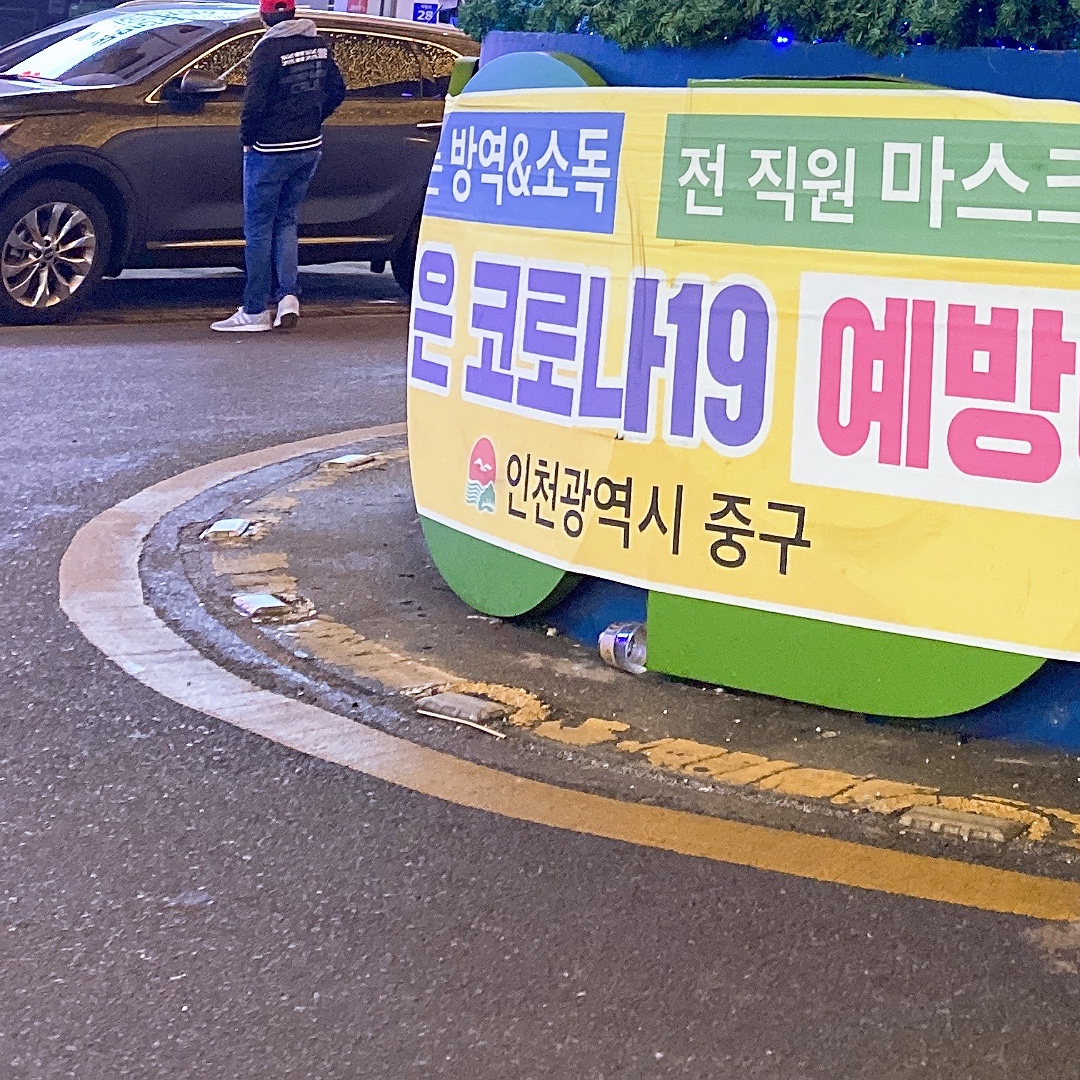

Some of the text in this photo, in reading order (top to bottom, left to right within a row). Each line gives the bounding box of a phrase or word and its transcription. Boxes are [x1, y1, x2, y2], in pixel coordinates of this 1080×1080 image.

[416, 10, 434, 21] 28
[450, 125, 611, 213] 방역&소독
[677, 143, 726, 217] 전
[748, 145, 856, 224] 직원
[411, 249, 770, 448] 은 코로나19
[506, 453, 812, 576] 인천광역시 중구
